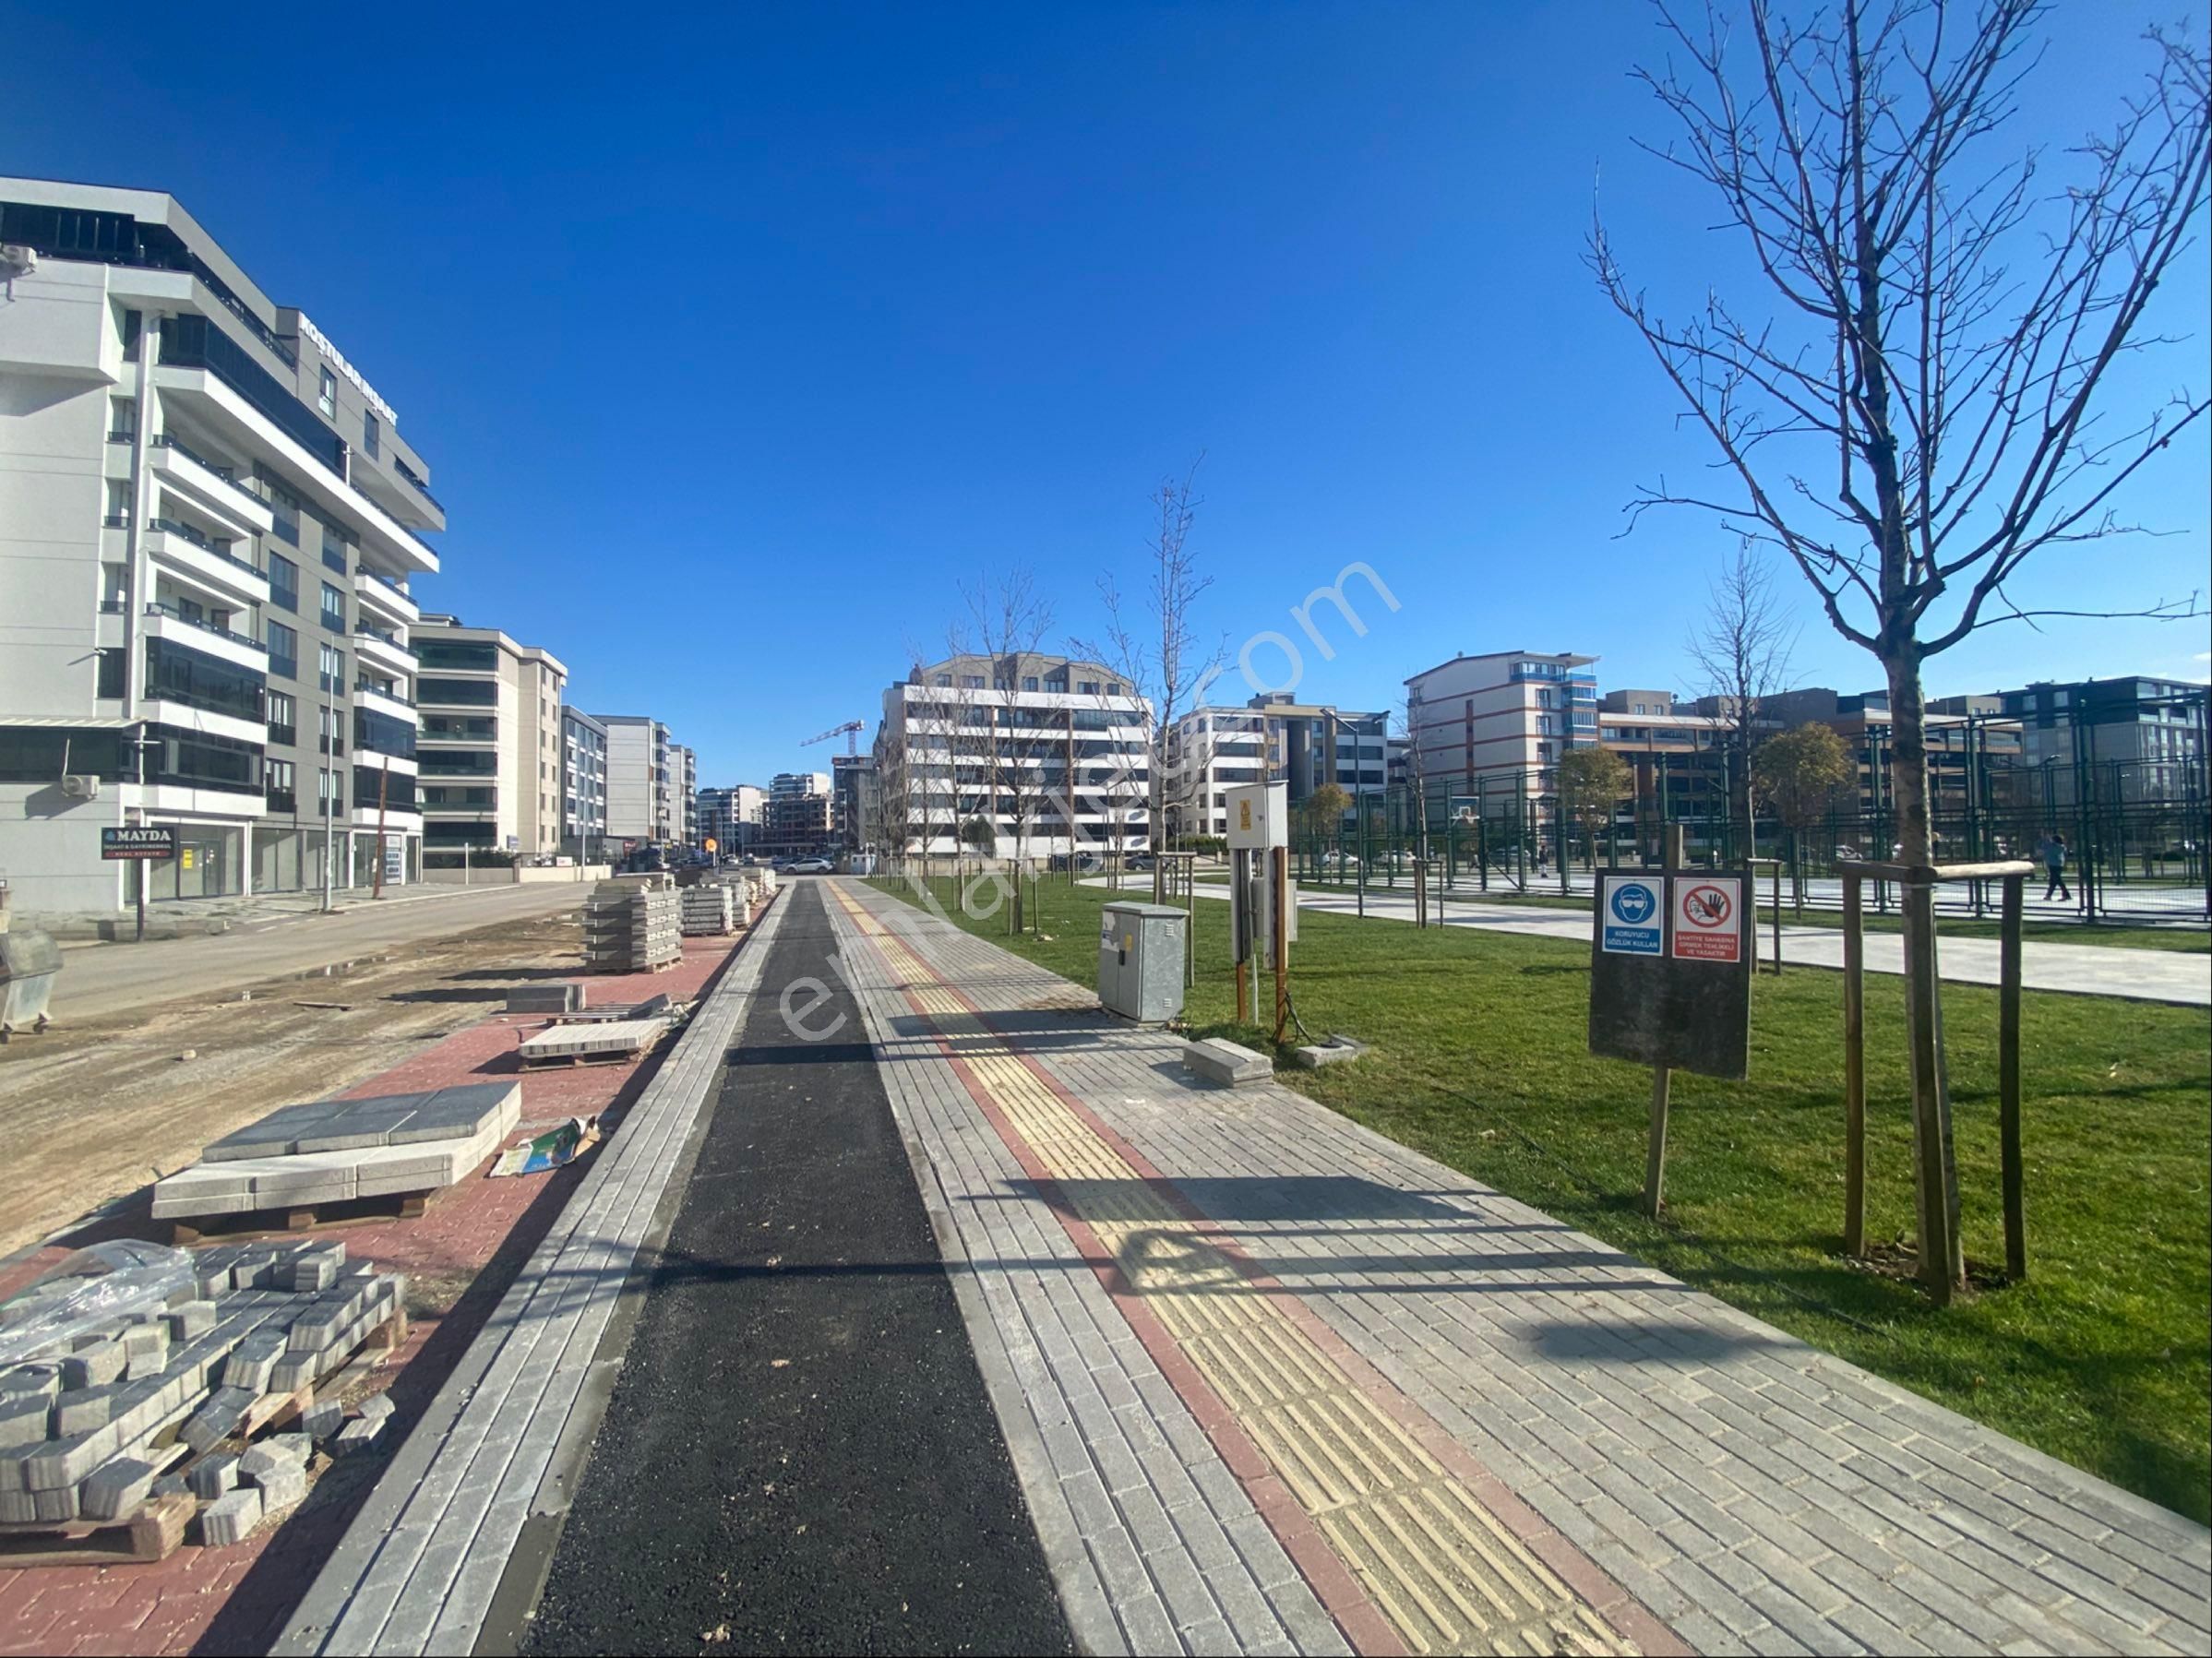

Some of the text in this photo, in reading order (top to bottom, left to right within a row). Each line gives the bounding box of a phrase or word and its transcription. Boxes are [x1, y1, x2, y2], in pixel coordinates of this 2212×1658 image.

[298, 310, 361, 391] KOŞTULAR
[117, 829, 172, 841] MAYDA
[1615, 930, 1650, 939] KORUYUCU
[1607, 937, 1658, 948] GÖZLÜK KULLAN
